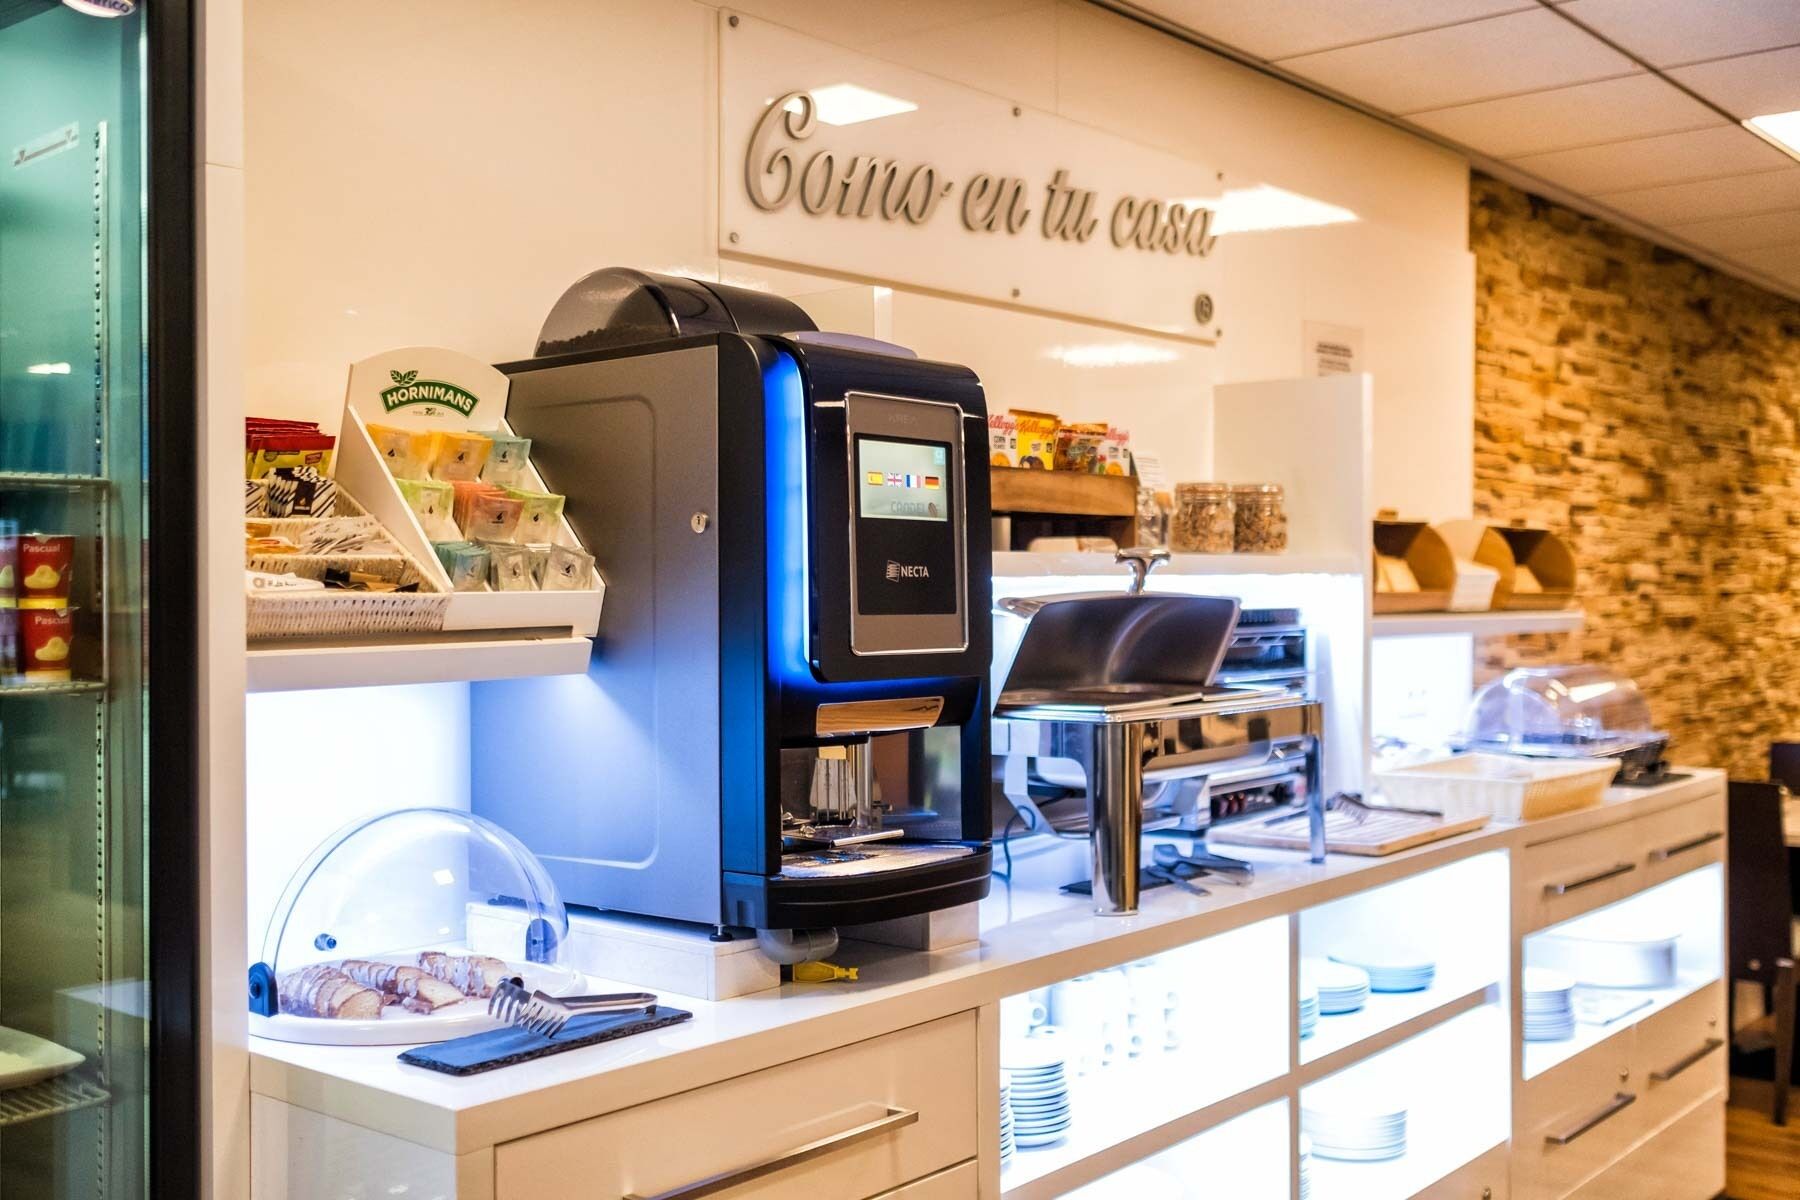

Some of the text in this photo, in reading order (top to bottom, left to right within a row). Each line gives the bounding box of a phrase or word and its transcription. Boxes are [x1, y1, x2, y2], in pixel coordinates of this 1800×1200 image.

[745, 91, 1218, 256] Como en tu casa
[386, 385, 473, 411] HORNIMANS
[23, 543, 61, 553] Pascual
[900, 565, 930, 578] NECTA
[34, 615, 70, 625] Pascual
